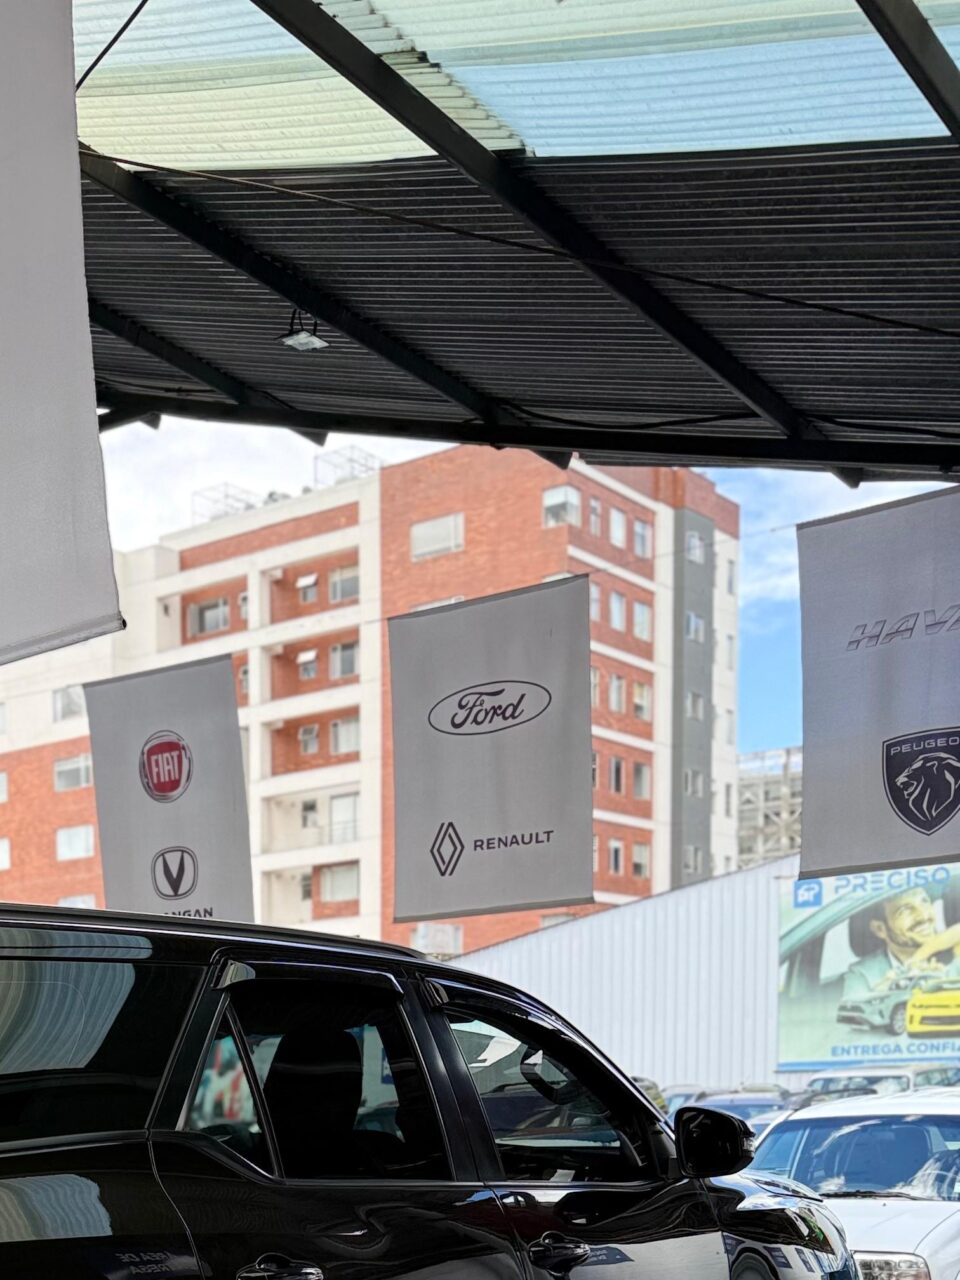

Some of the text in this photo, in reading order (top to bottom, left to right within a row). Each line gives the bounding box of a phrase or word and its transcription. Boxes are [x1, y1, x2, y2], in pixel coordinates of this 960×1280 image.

[450, 688, 526, 729] Ford
[150, 750, 180, 785] FIAT
[473, 829, 554, 852] RENAULT
[834, 866, 951, 895] PRECISO
[831, 1042, 904, 1057] ENTREGA
